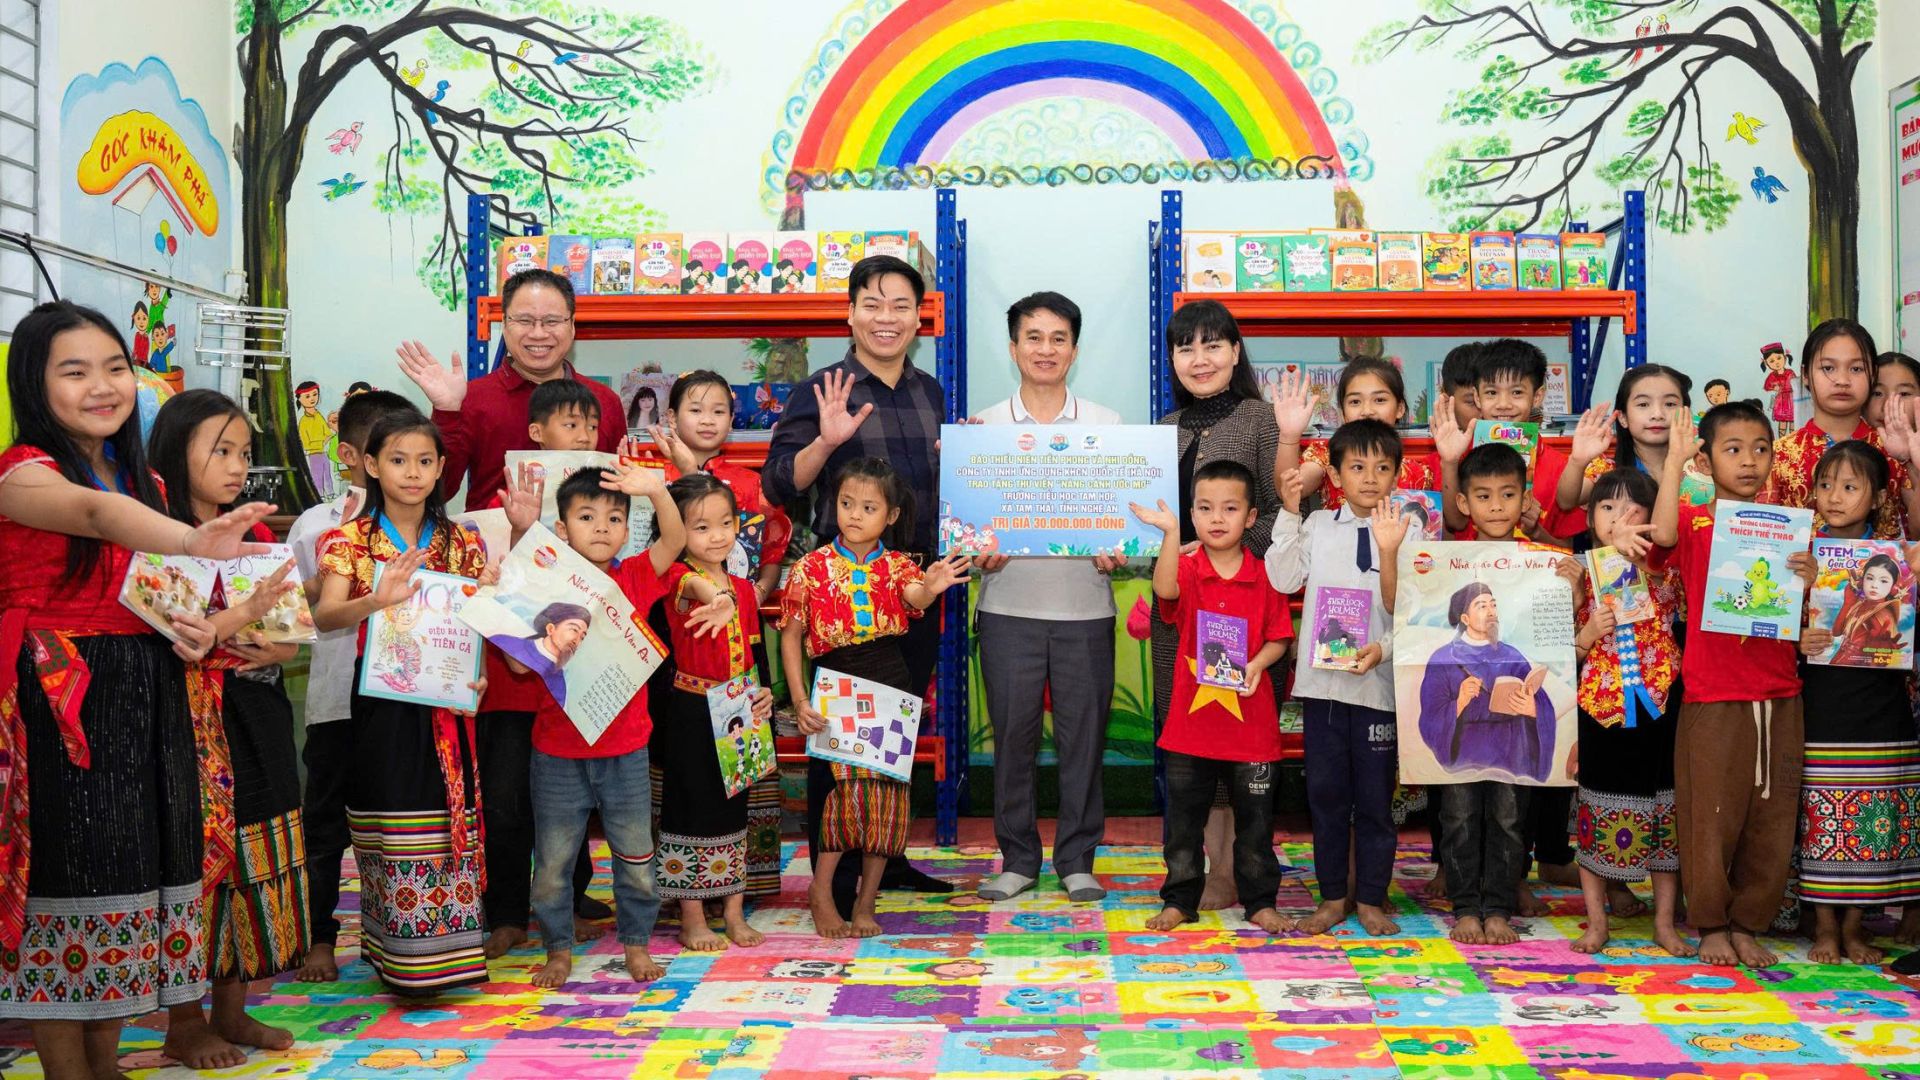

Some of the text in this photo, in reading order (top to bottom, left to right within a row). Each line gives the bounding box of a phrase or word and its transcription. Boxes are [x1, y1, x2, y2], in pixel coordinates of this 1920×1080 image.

[100, 127, 208, 210] GÓC KHÁM PHÁ
[520, 244, 530, 253] 10
[652, 242, 663, 250] 10
[1060, 455, 1089, 464] PHONG
[1091, 454, 1104, 464] VÀ
[1105, 455, 1121, 464] NHI
[982, 468, 991, 476] TY
[995, 467, 1016, 476] TNHH
[1064, 467, 1088, 477] KHCN
[967, 480, 989, 488] TRAO
[1079, 492, 1096, 500] TAM
[1016, 504, 1032, 512] TAM
[1106, 504, 1118, 513] AN
[992, 514, 1125, 532] TRỊ GIÁ 30.000.000 ĐỒNG
[1772, 532, 1794, 541] THAO
[1818, 546, 1853, 558] STEM
[1828, 558, 1845, 569] Gen
[1328, 605, 1361, 617] HOLMES
[1209, 629, 1238, 642] HOLMES
[432, 637, 455, 649] TIÊN
